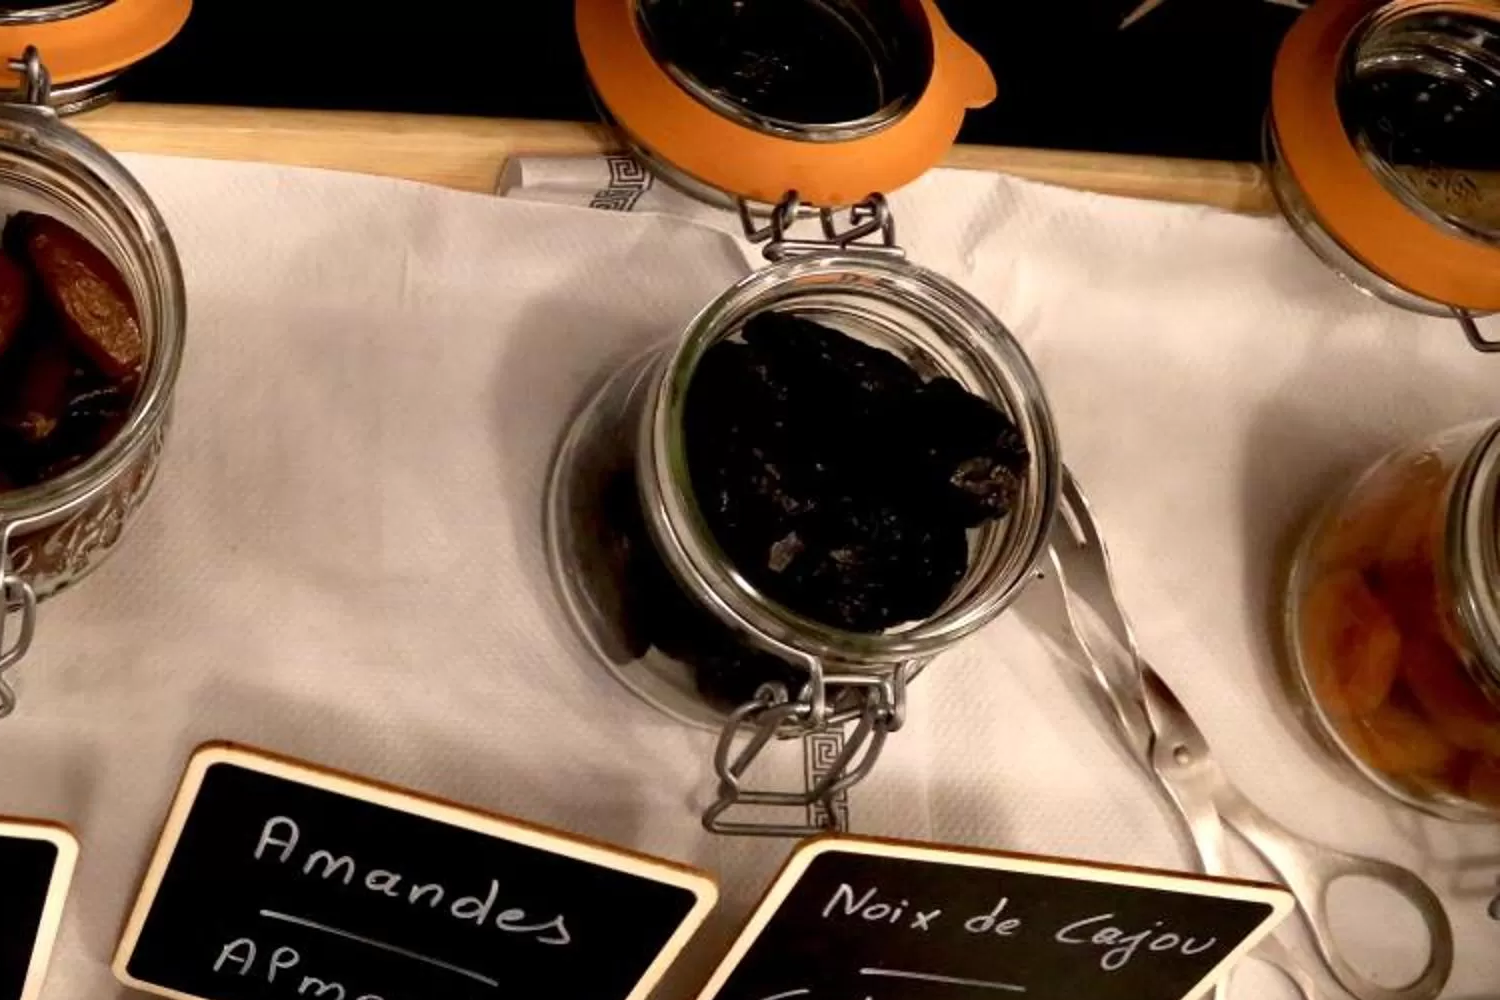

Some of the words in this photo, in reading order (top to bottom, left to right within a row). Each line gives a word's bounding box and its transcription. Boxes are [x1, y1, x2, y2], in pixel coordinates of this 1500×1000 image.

[254, 816, 572, 945] Amandes
[822, 882, 943, 932] Noix
[965, 898, 1021, 936] de
[1055, 913, 1217, 970] Cajou
